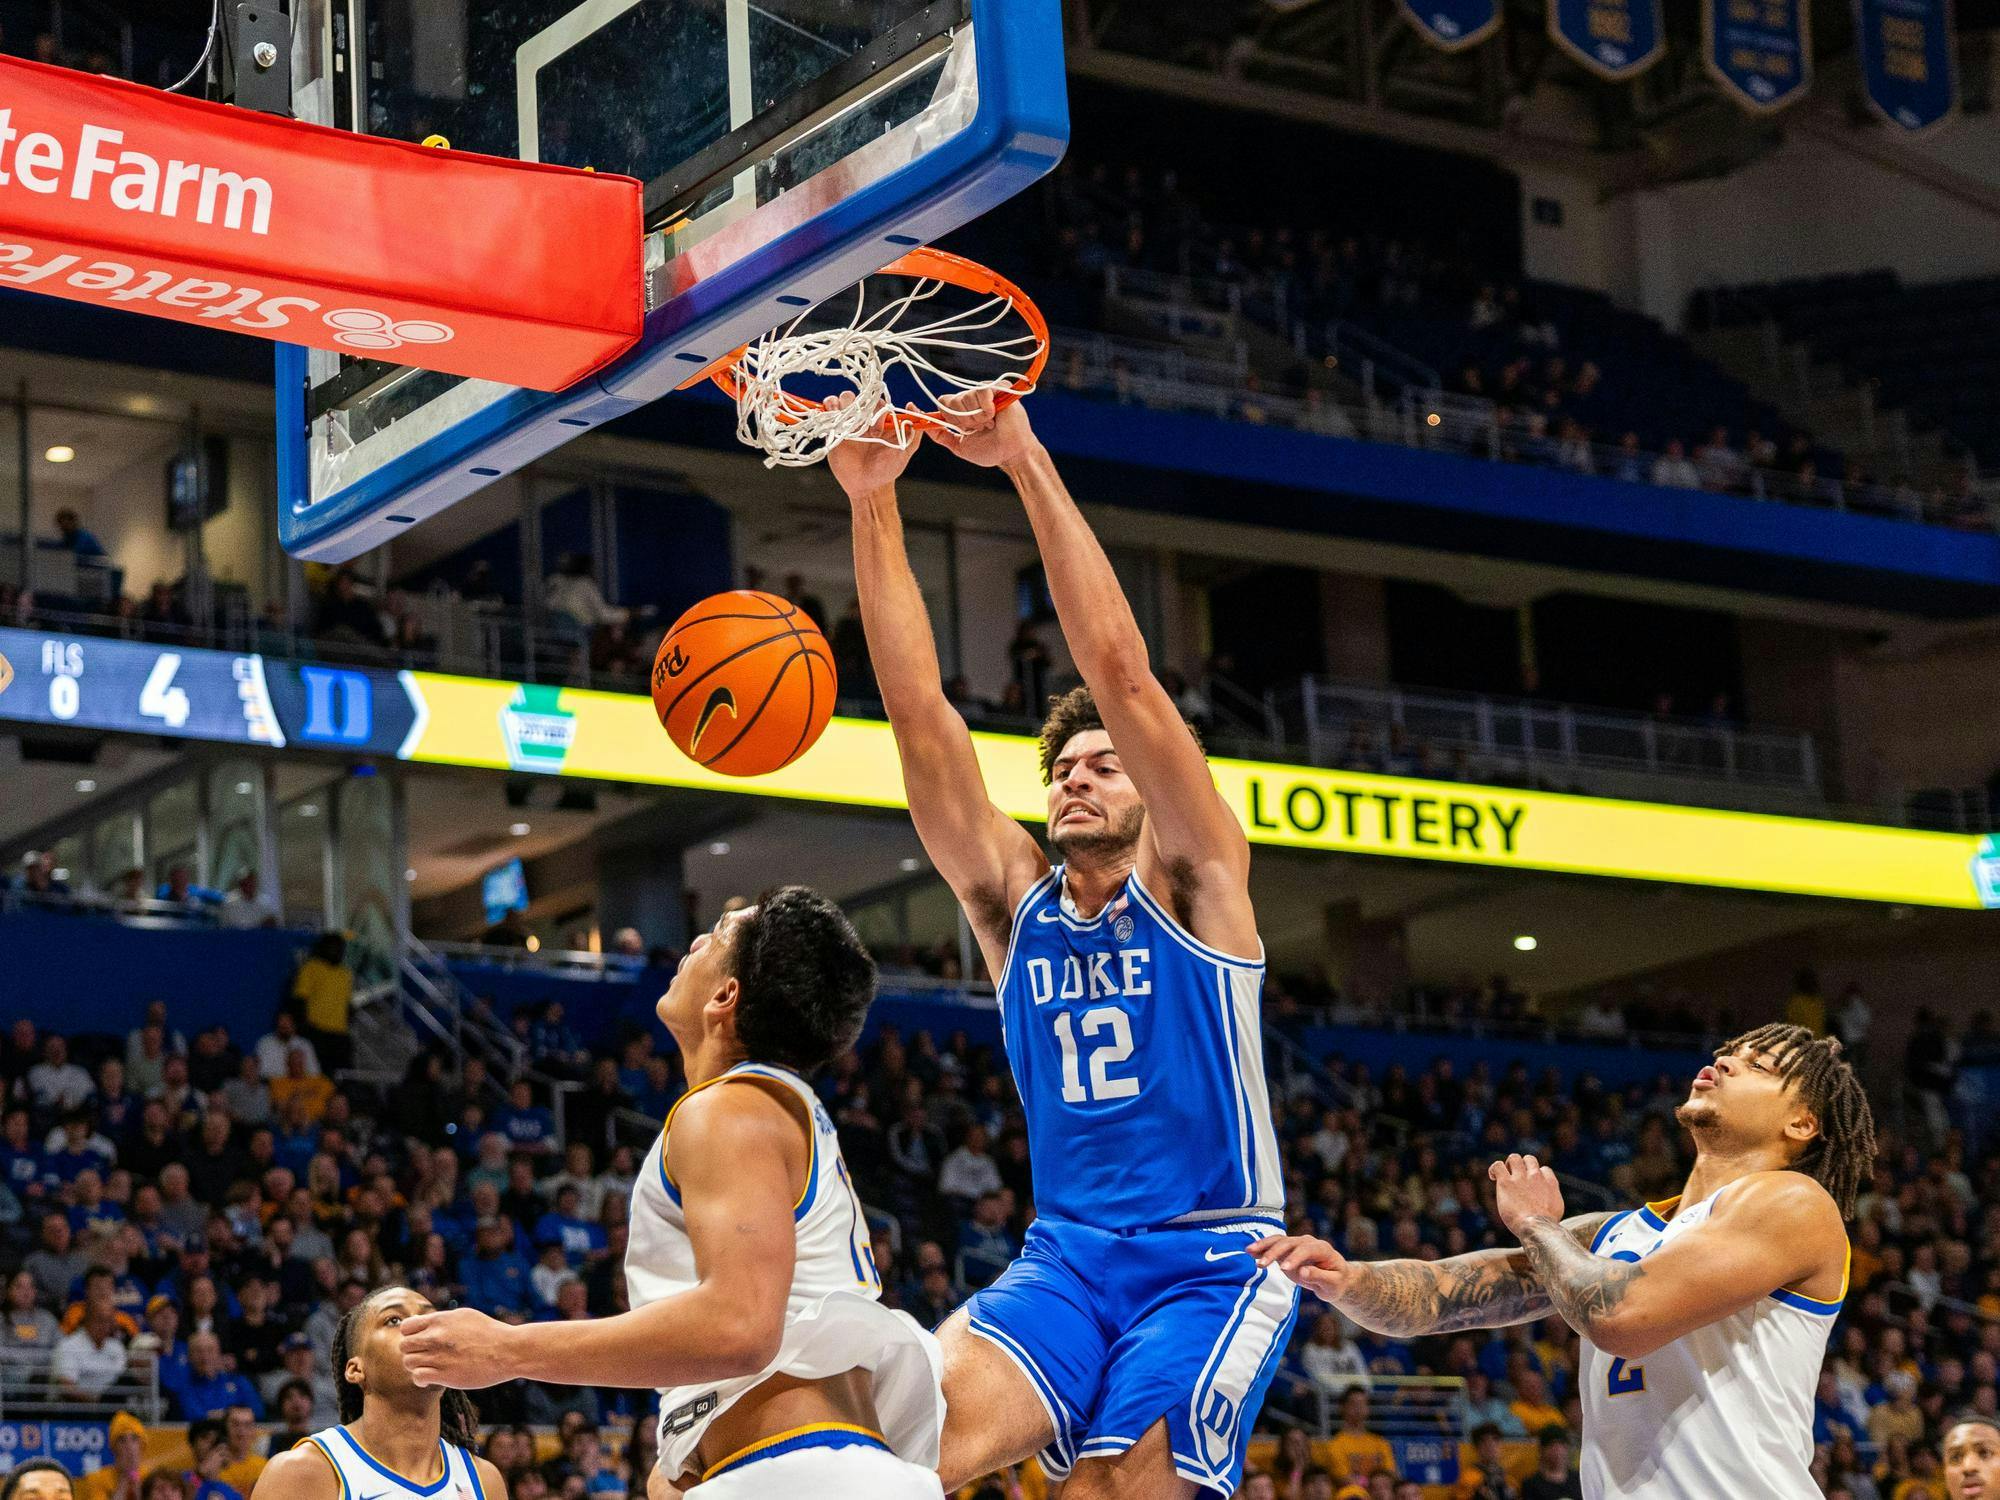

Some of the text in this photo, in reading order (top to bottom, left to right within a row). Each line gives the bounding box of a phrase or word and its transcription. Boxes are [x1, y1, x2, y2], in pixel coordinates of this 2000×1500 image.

[41, 640, 84, 677] FLS
[50, 674, 80, 720] 0
[139, 653, 190, 727] 4
[1251, 781, 1523, 852] LOTTERY
[1027, 948, 1151, 1005] DUKE
[1054, 1006, 1140, 1103] 12
